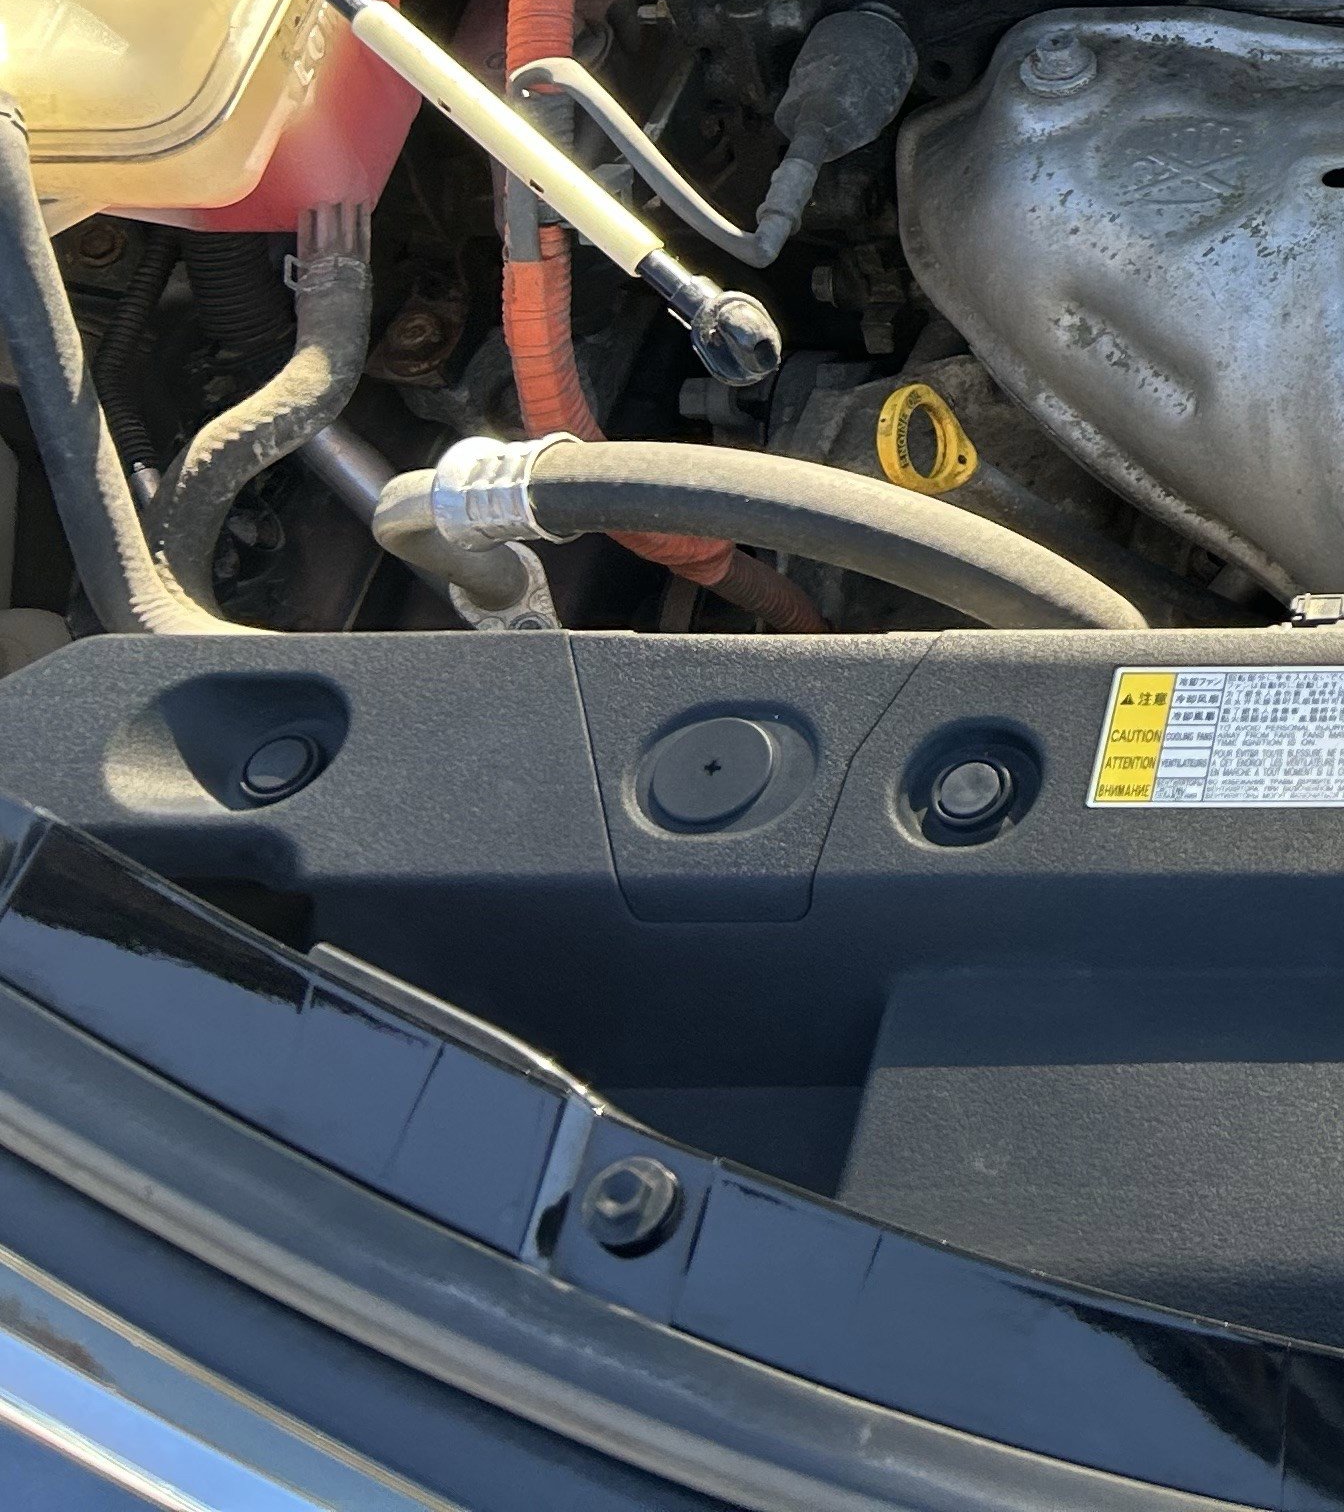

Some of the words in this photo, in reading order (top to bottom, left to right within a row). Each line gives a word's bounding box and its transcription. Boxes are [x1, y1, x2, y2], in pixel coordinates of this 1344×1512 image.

[1111, 729, 1162, 743] CAUTION
[1105, 755, 1158, 769] ATTENTION
[1098, 783, 1153, 797] ВНИМАНИЕ
